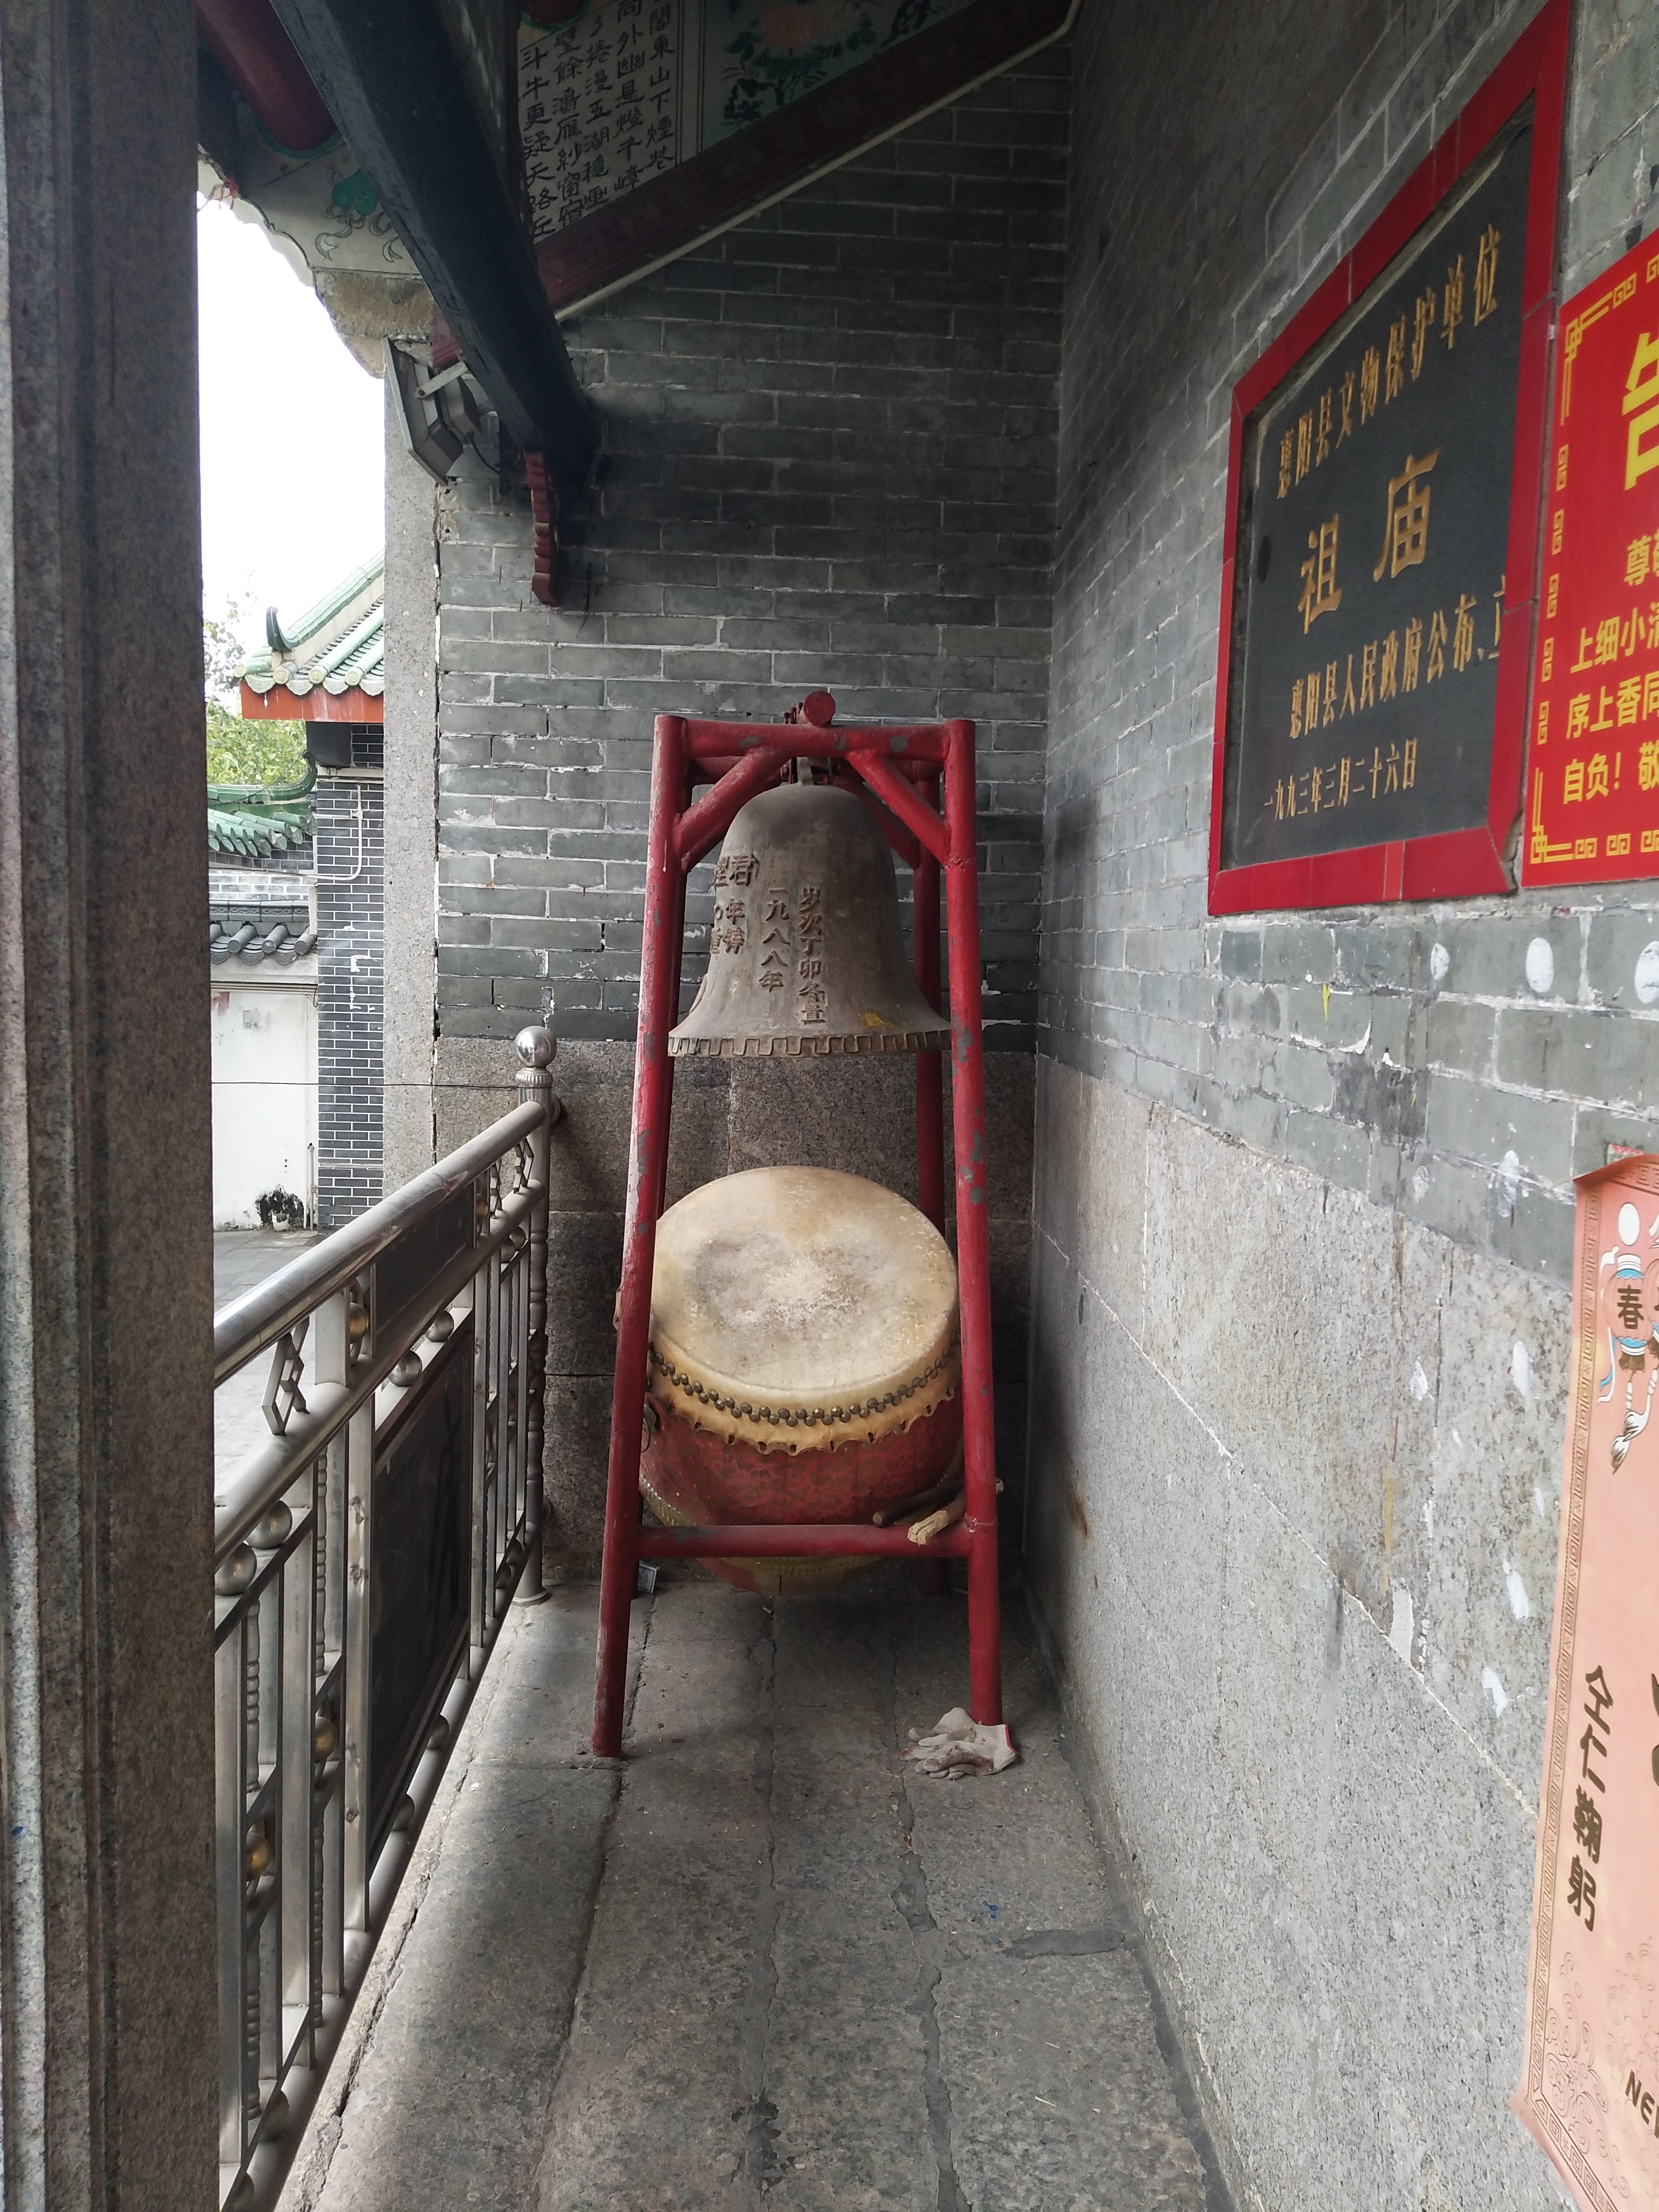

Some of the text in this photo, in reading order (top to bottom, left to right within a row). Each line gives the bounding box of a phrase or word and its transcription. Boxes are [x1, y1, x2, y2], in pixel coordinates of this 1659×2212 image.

[1277, 223, 1501, 500] 惠阳县文物保护单位
[1298, 450, 1439, 635] 祖庙
[1624, 528, 1659, 586] 尊
[1264, 736, 1417, 822] 一九九三年三月二十六日
[758, 887, 791, 993] 一九八八年
[1617, 1285, 1644, 1329] 春
